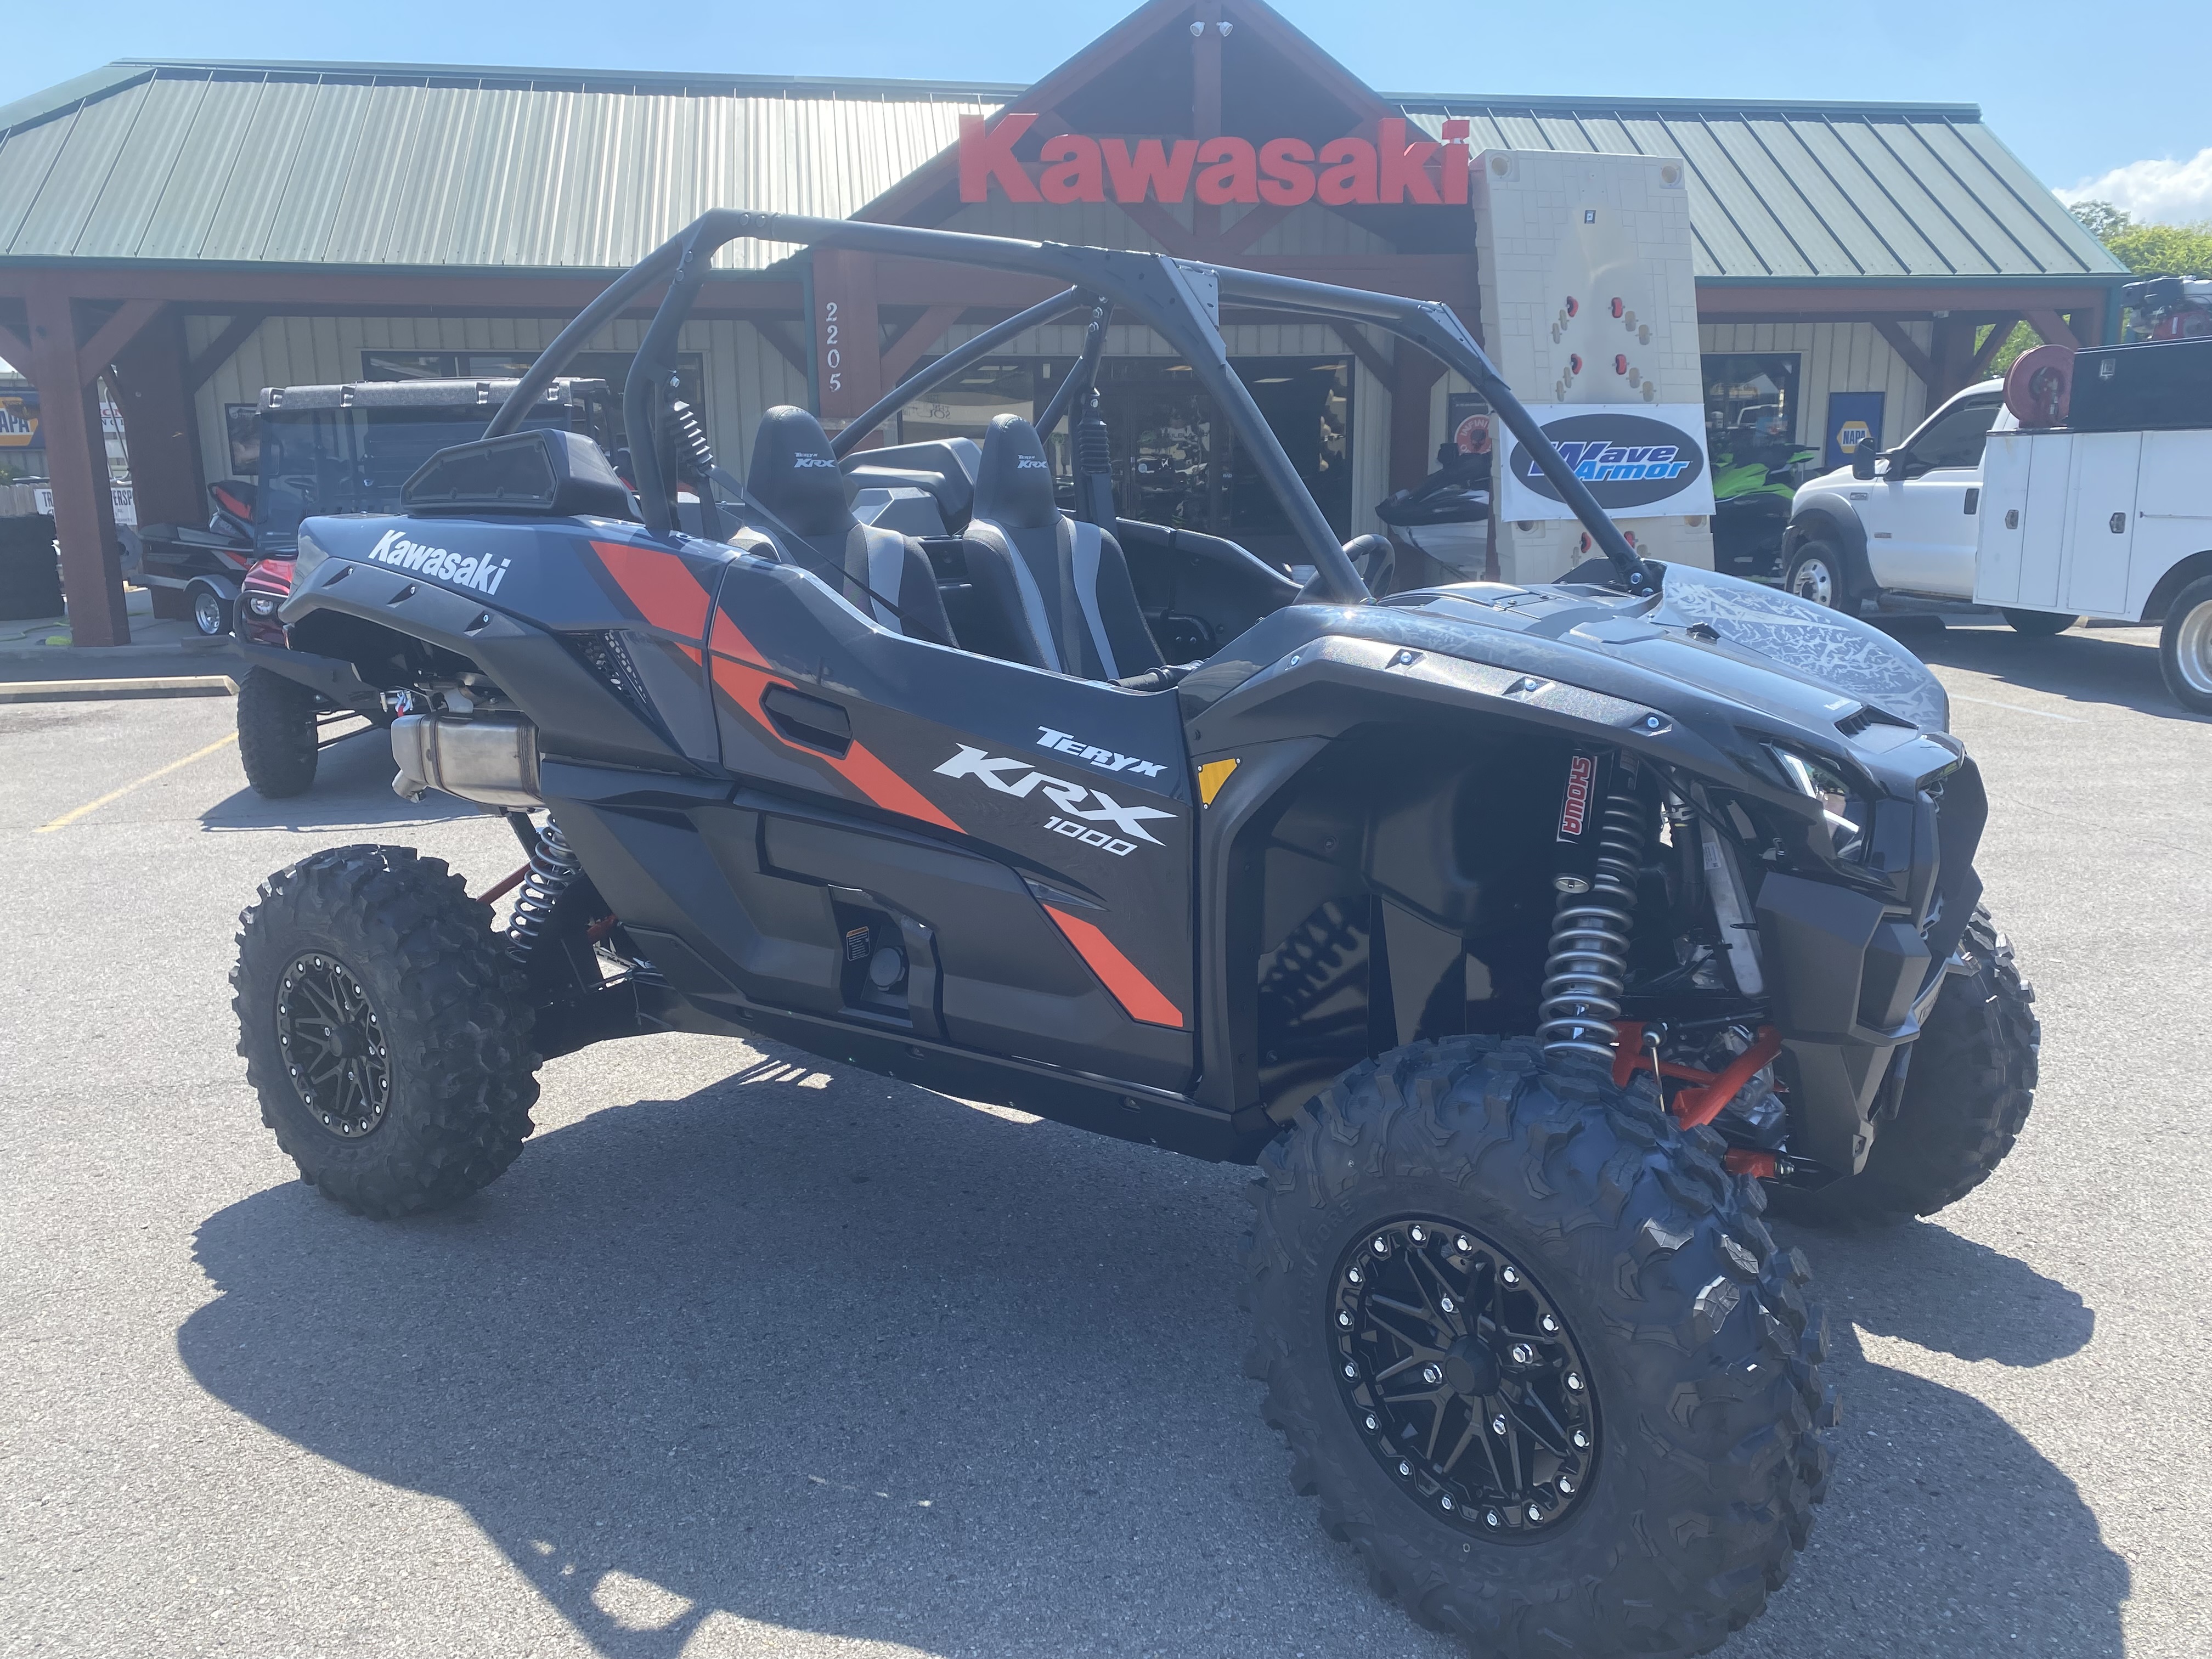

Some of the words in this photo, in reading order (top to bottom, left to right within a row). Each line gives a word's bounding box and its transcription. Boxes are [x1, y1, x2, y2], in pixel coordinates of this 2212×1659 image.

[960, 113, 1470, 205] Kawasaki
[826, 302, 840, 392] 2205
[794, 458, 836, 467] KRX
[1527, 441, 1679, 476] Wave
[1574, 460, 1690, 481] Armor
[368, 529, 511, 596] Kawasaki
[1036, 725, 1168, 777] TERYX
[933, 743, 1178, 847] KRX
[1561, 755, 1591, 836] SHOWA
[1043, 816, 1138, 856] 1000
